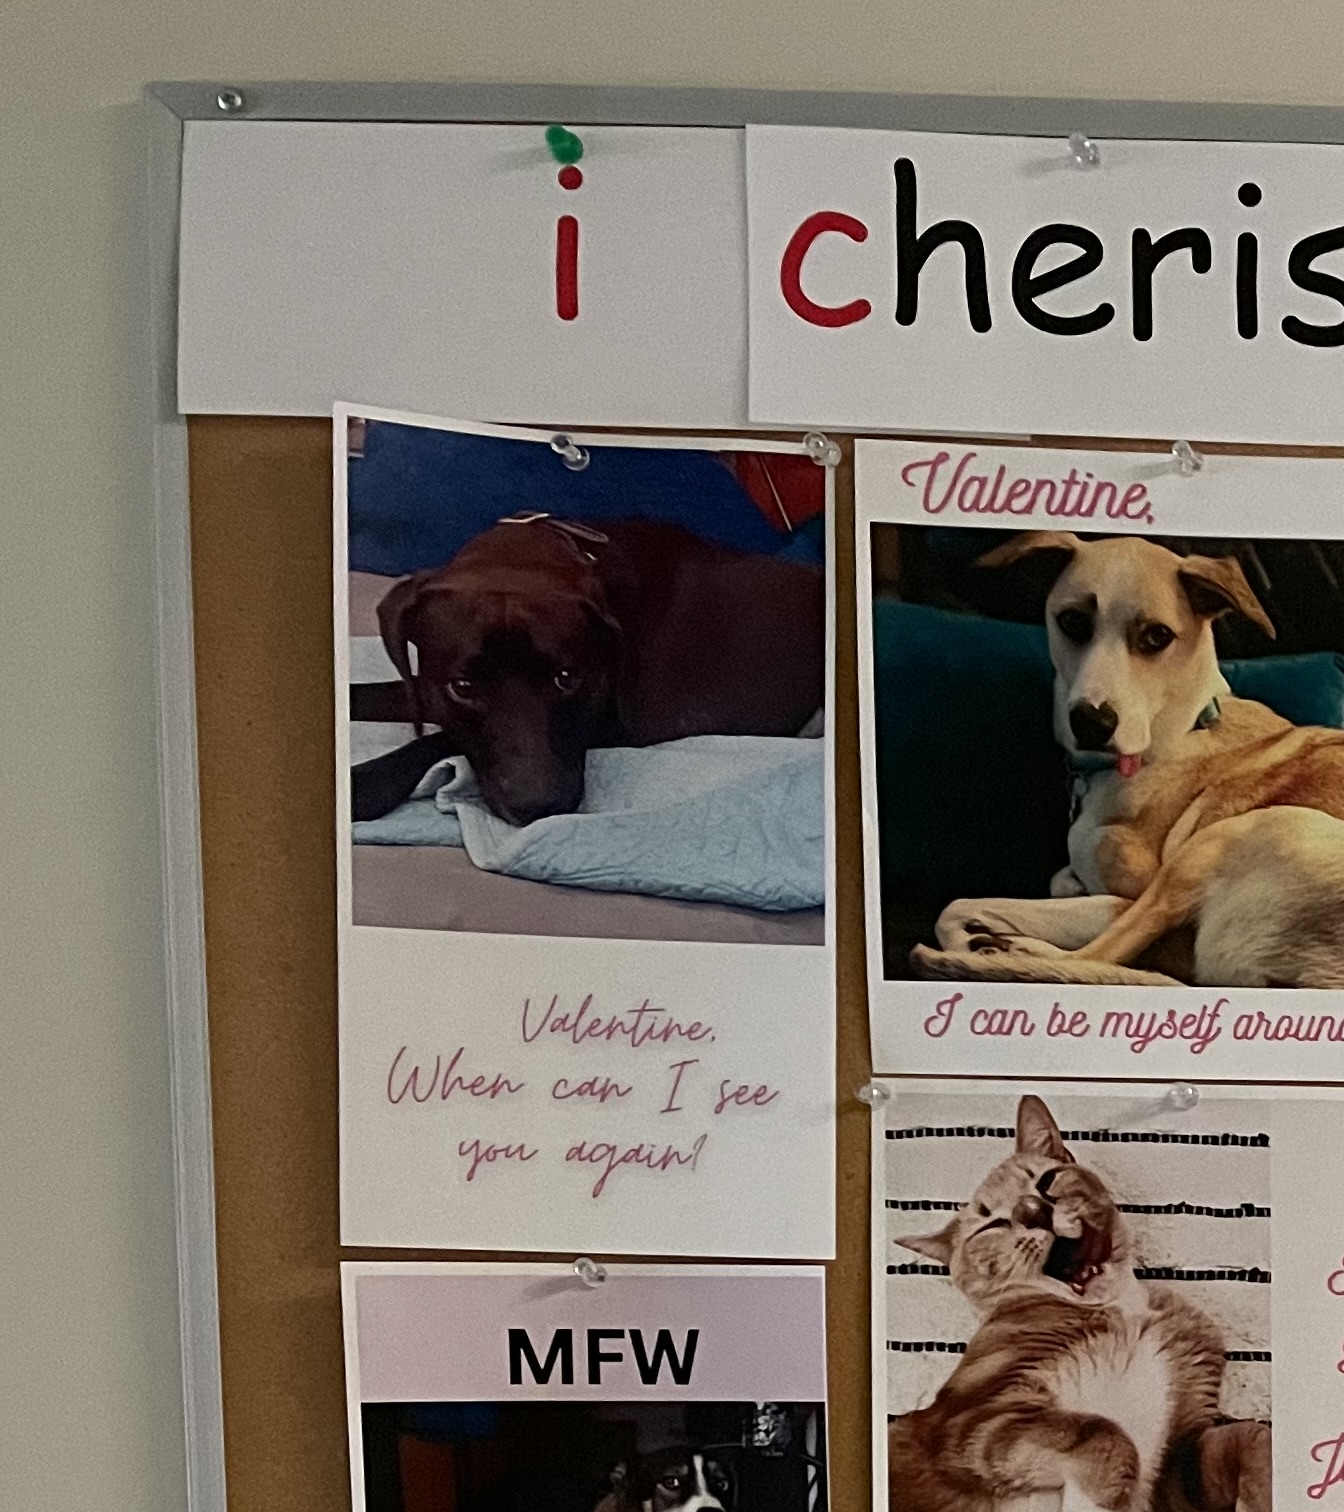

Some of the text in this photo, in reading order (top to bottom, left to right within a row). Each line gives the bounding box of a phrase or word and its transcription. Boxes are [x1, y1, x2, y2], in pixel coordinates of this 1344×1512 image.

[924, 993, 964, 1038] I
[970, 1004, 1036, 1037] can
[1046, 1002, 1090, 1037] be
[1100, 999, 1229, 1054] myself
[387, 1046, 779, 1114] When can I see
[458, 1138, 538, 1181] you
[508, 1328, 699, 1385] MFW
